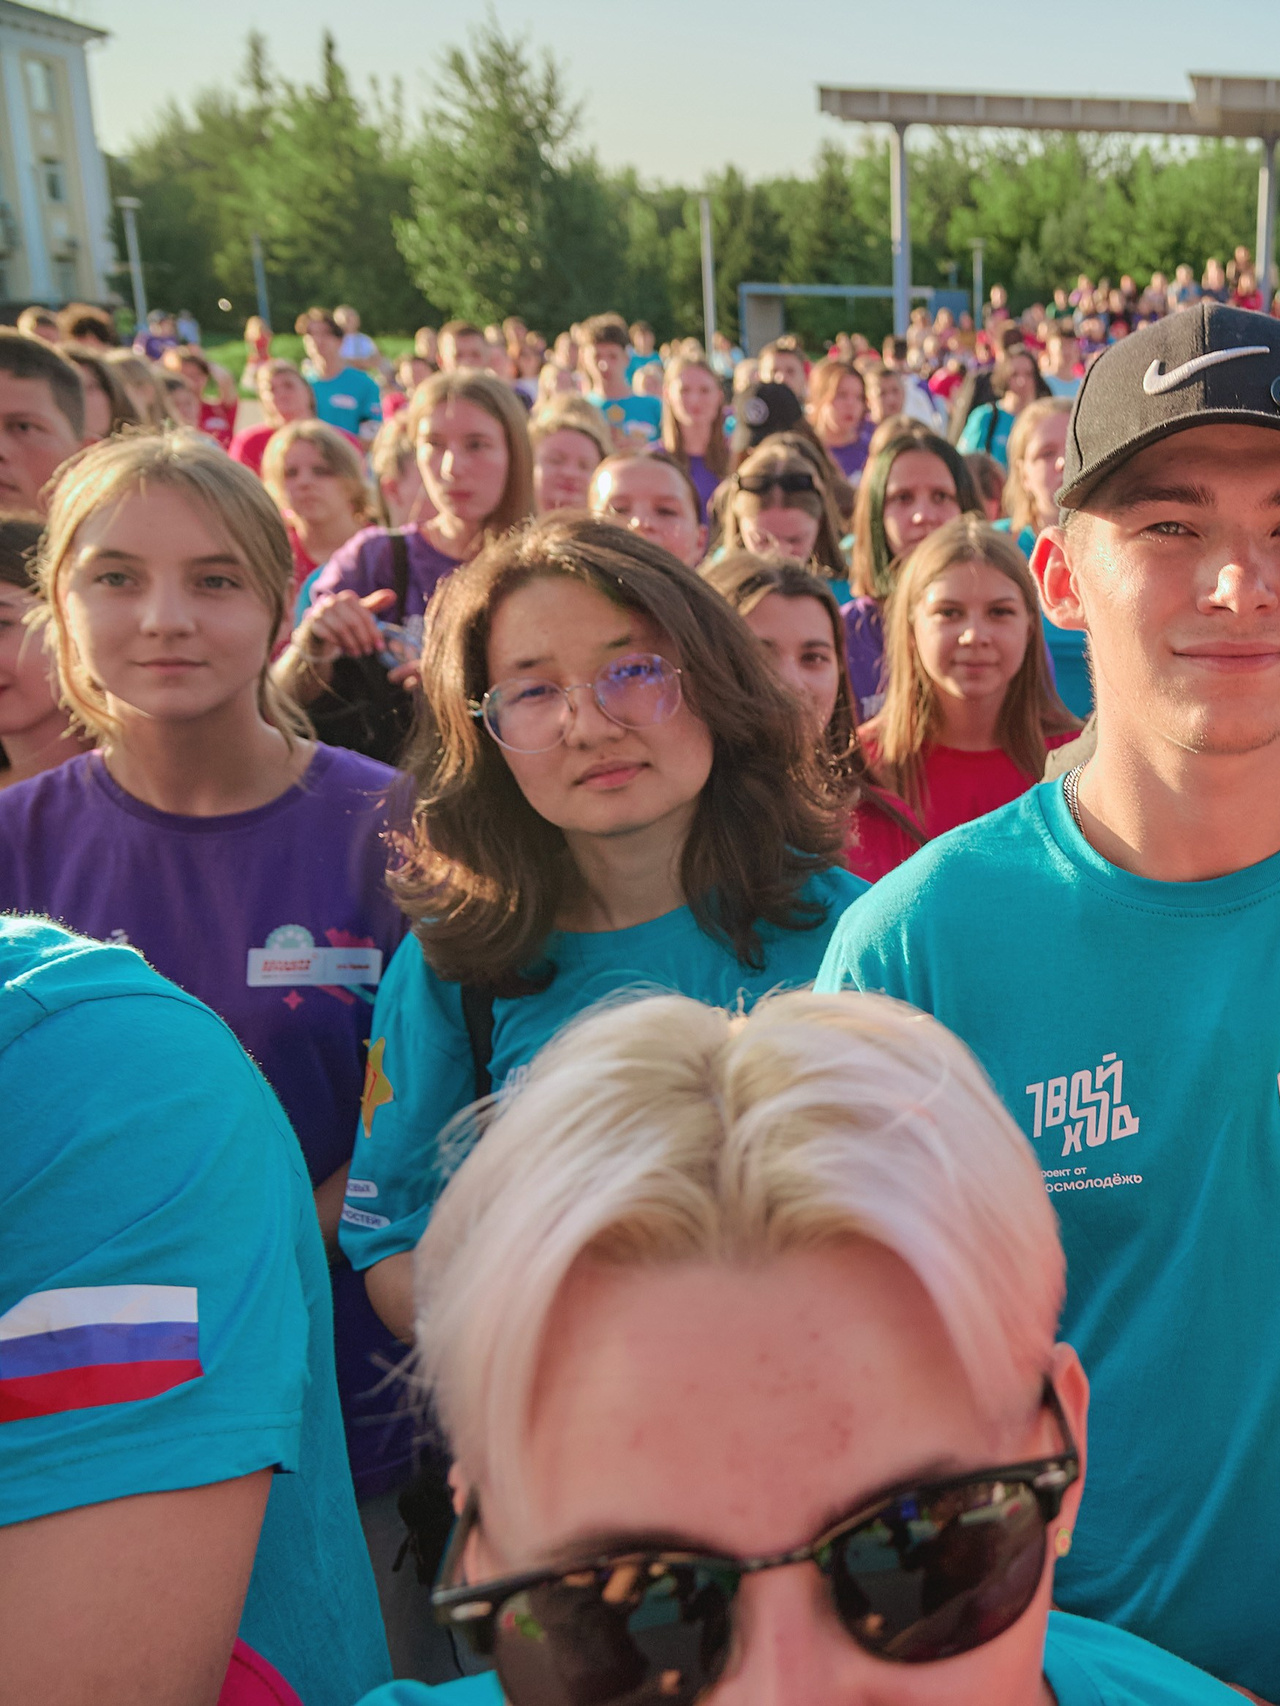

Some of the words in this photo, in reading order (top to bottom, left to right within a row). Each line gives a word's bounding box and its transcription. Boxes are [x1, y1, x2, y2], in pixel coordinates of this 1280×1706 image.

[1026, 1052, 1123, 1138] ТВОЙ
[1061, 1090, 1139, 1157] ХОД
[1040, 1168, 1071, 1179] роект
[1073, 1166, 1088, 1176] от
[1045, 1172, 1143, 1193] осмолодёжь
